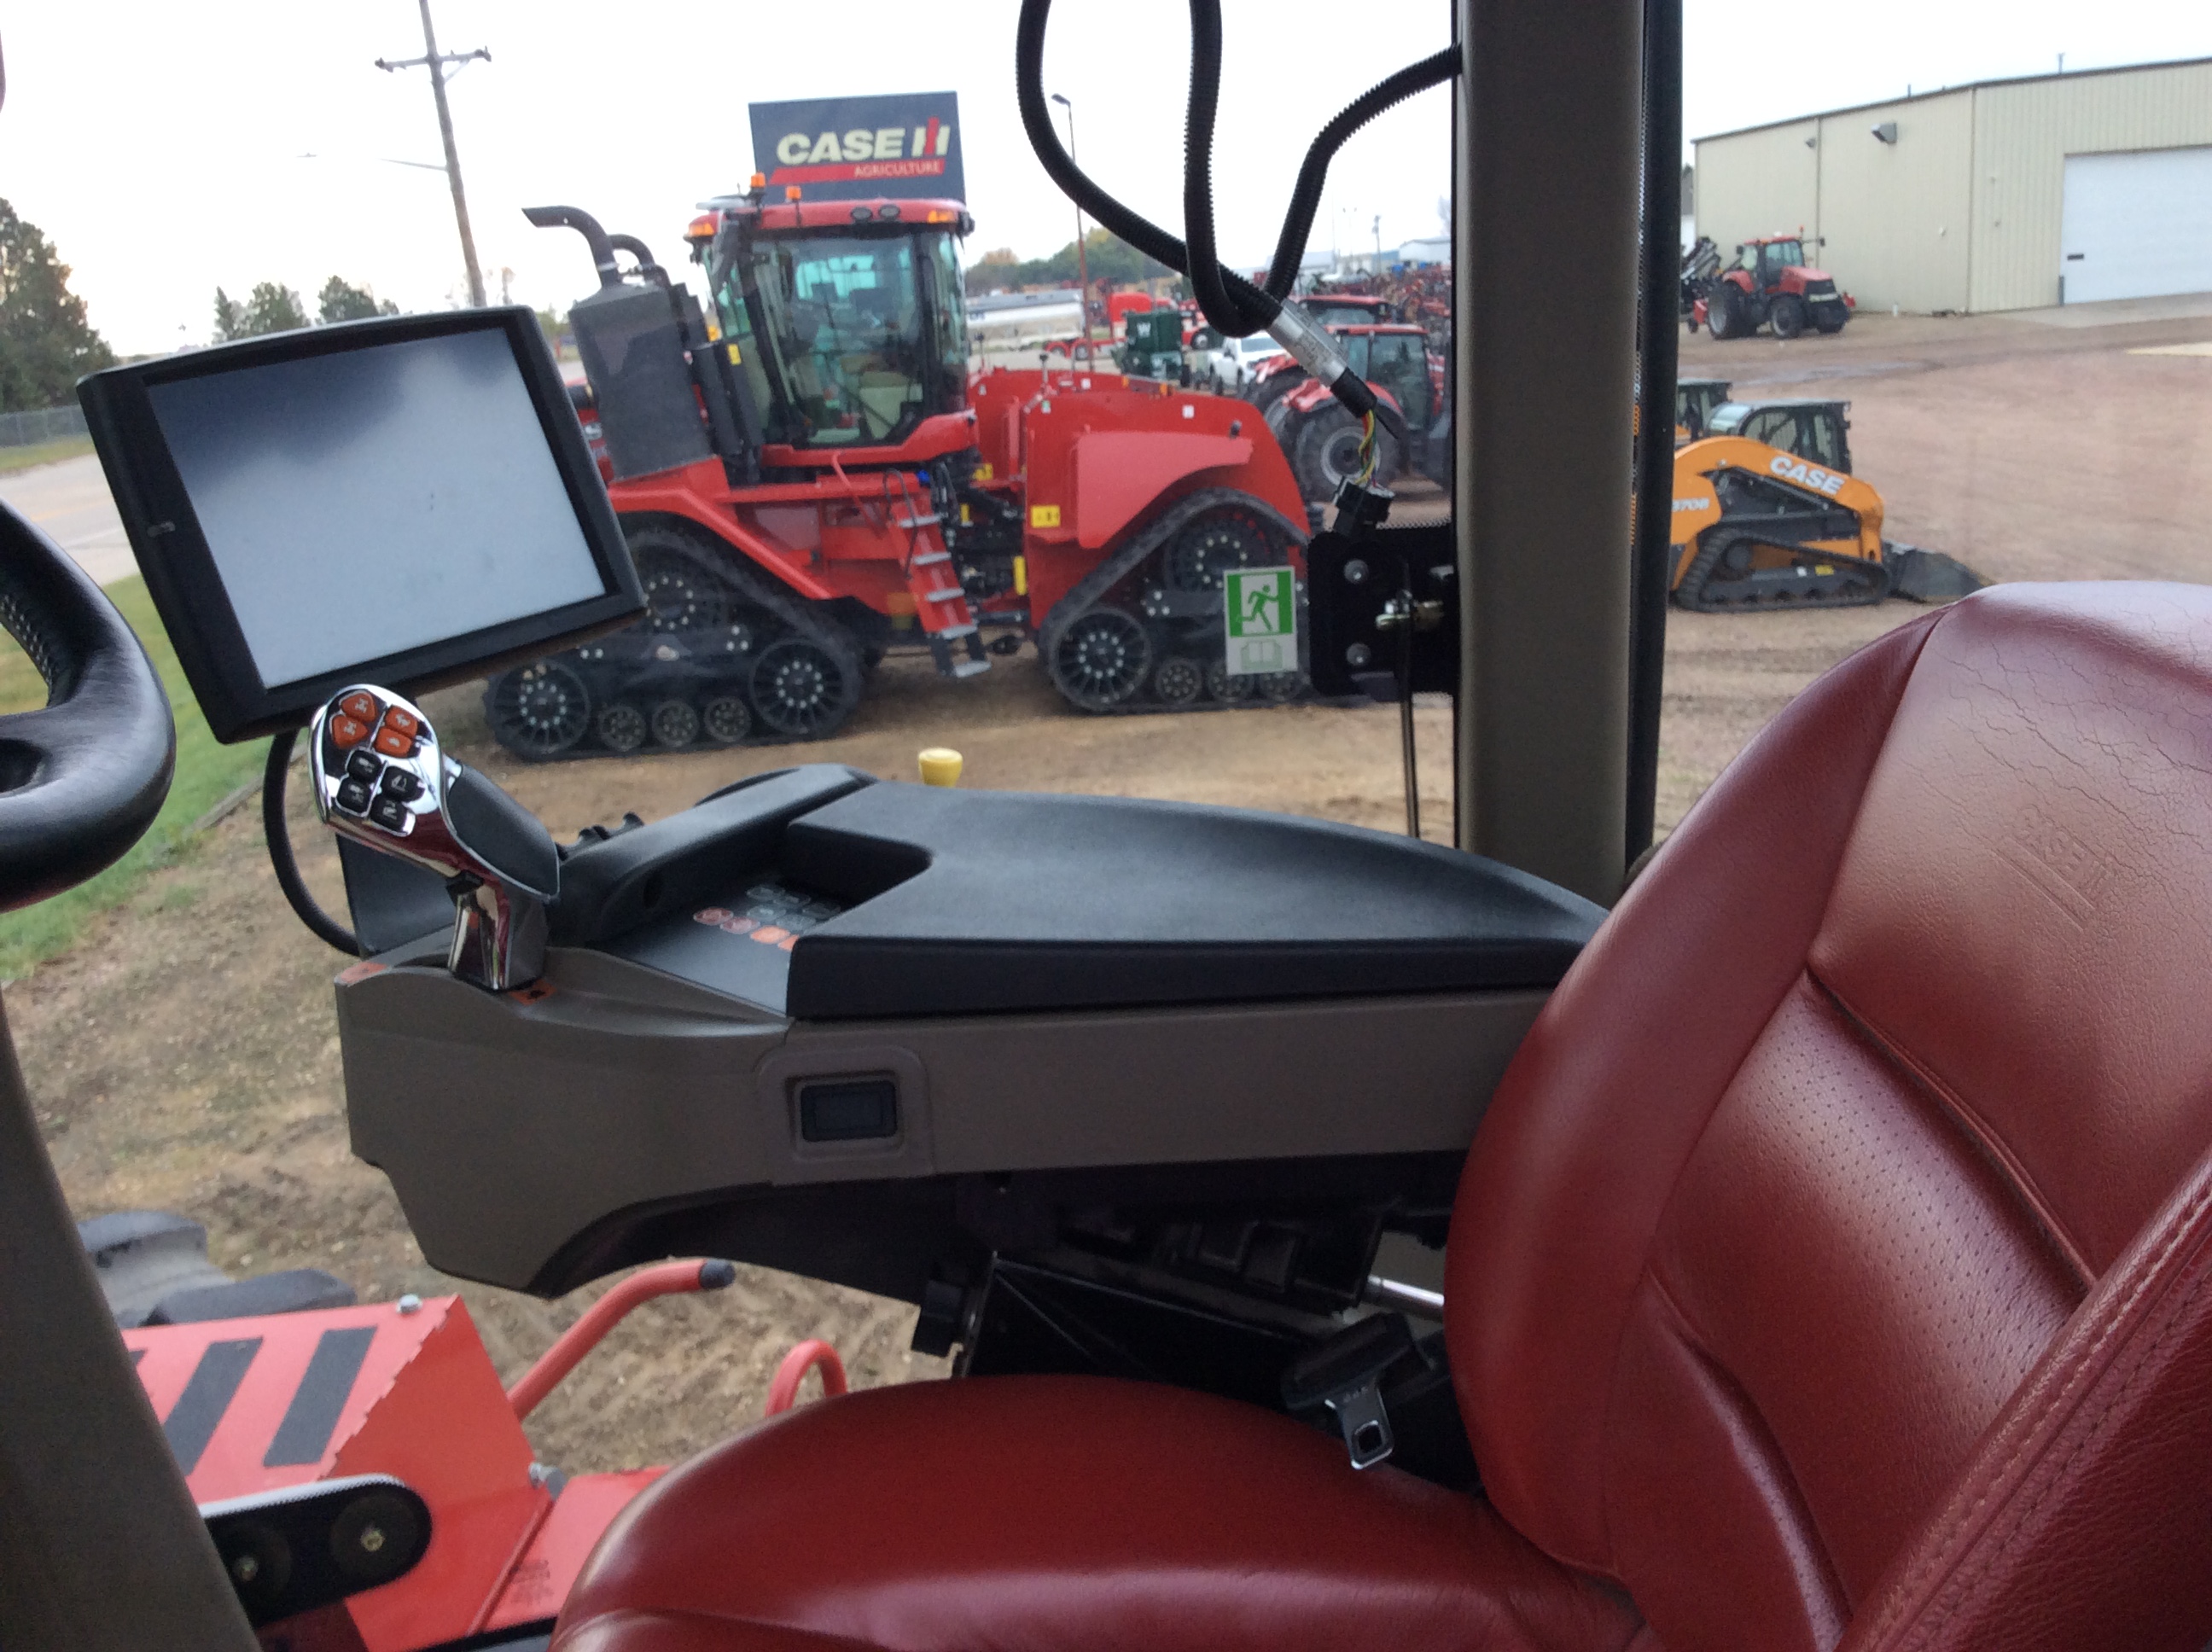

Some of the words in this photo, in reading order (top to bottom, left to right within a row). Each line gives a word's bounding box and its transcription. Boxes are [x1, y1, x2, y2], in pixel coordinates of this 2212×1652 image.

[777, 128, 905, 166] CASE
[854, 160, 940, 178] AGRICULTURE
[1770, 456, 1845, 496] CASE
